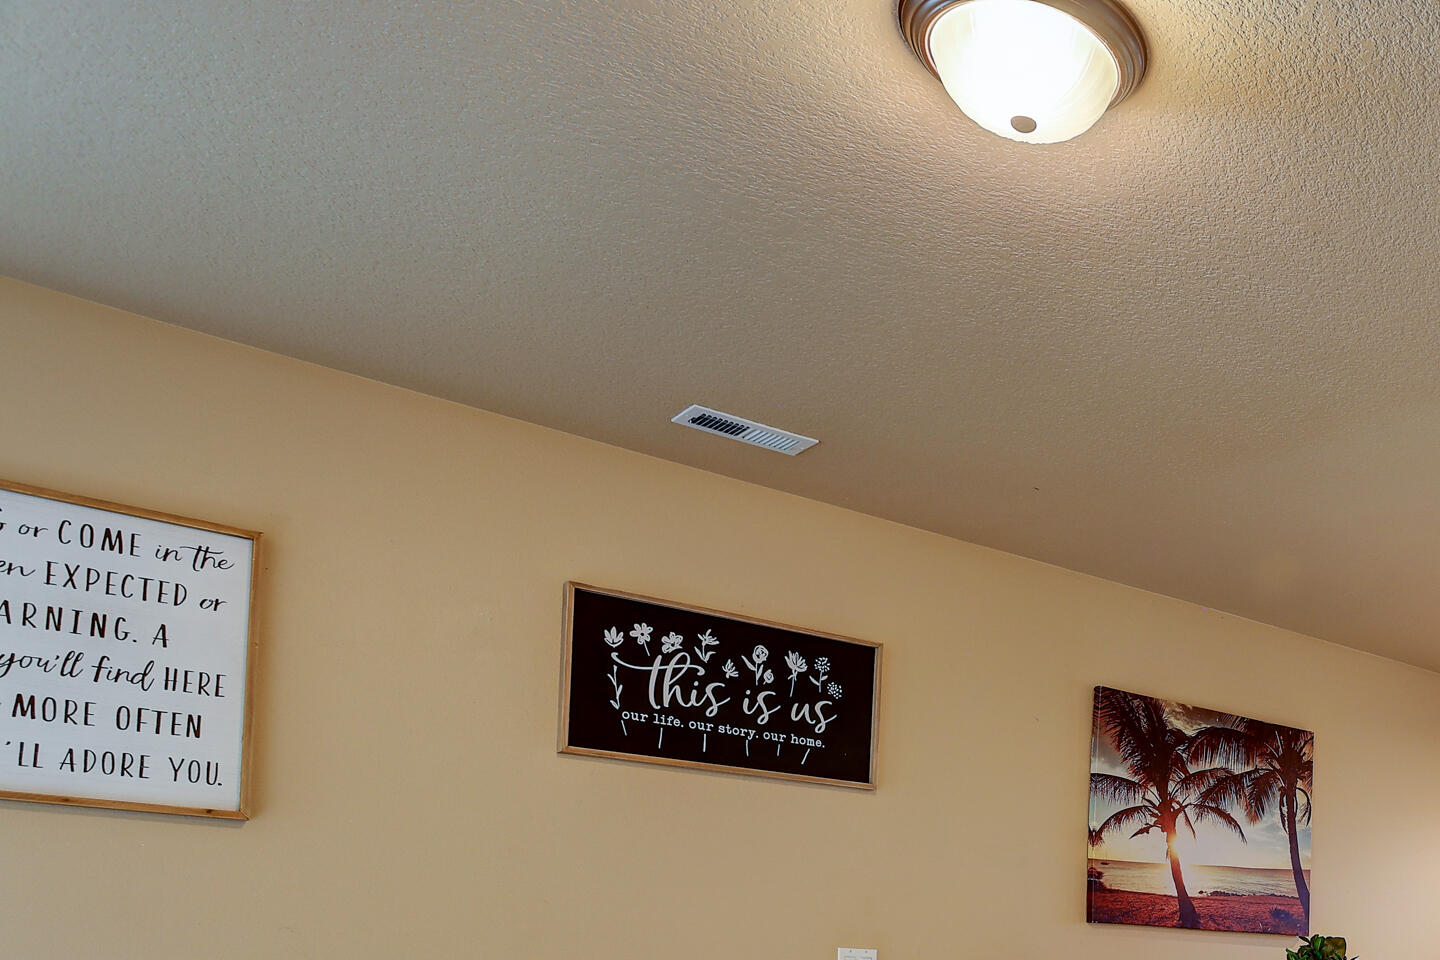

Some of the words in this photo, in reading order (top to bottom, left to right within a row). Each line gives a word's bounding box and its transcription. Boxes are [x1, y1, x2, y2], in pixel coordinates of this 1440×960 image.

[18, 523, 48, 538] or
[58, 519, 142, 557] COME
[155, 543, 183, 562] in
[181, 545, 235, 573] the
[44, 560, 188, 607] EXPECTED
[199, 598, 227, 612] or
[0, 599, 138, 643] ARNING.
[152, 623, 170, 648] A
[0, 650, 84, 679] you'll
[92, 655, 155, 692] find
[164, 666, 226, 698] HERE
[611, 651, 731, 718] this
[742, 689, 781, 725] is
[790, 700, 838, 734] us
[11, 693, 97, 727] MORE
[115, 705, 202, 739] OFTEN
[621, 711, 649, 722] our
[653, 712, 684, 729] life.
[688, 719, 714, 732] our
[718, 723, 759, 741] story.
[763, 731, 787, 743] our
[790, 733, 826, 748] home.
[59, 748, 150, 780] ADORE
[168, 756, 223, 787] YOU.
